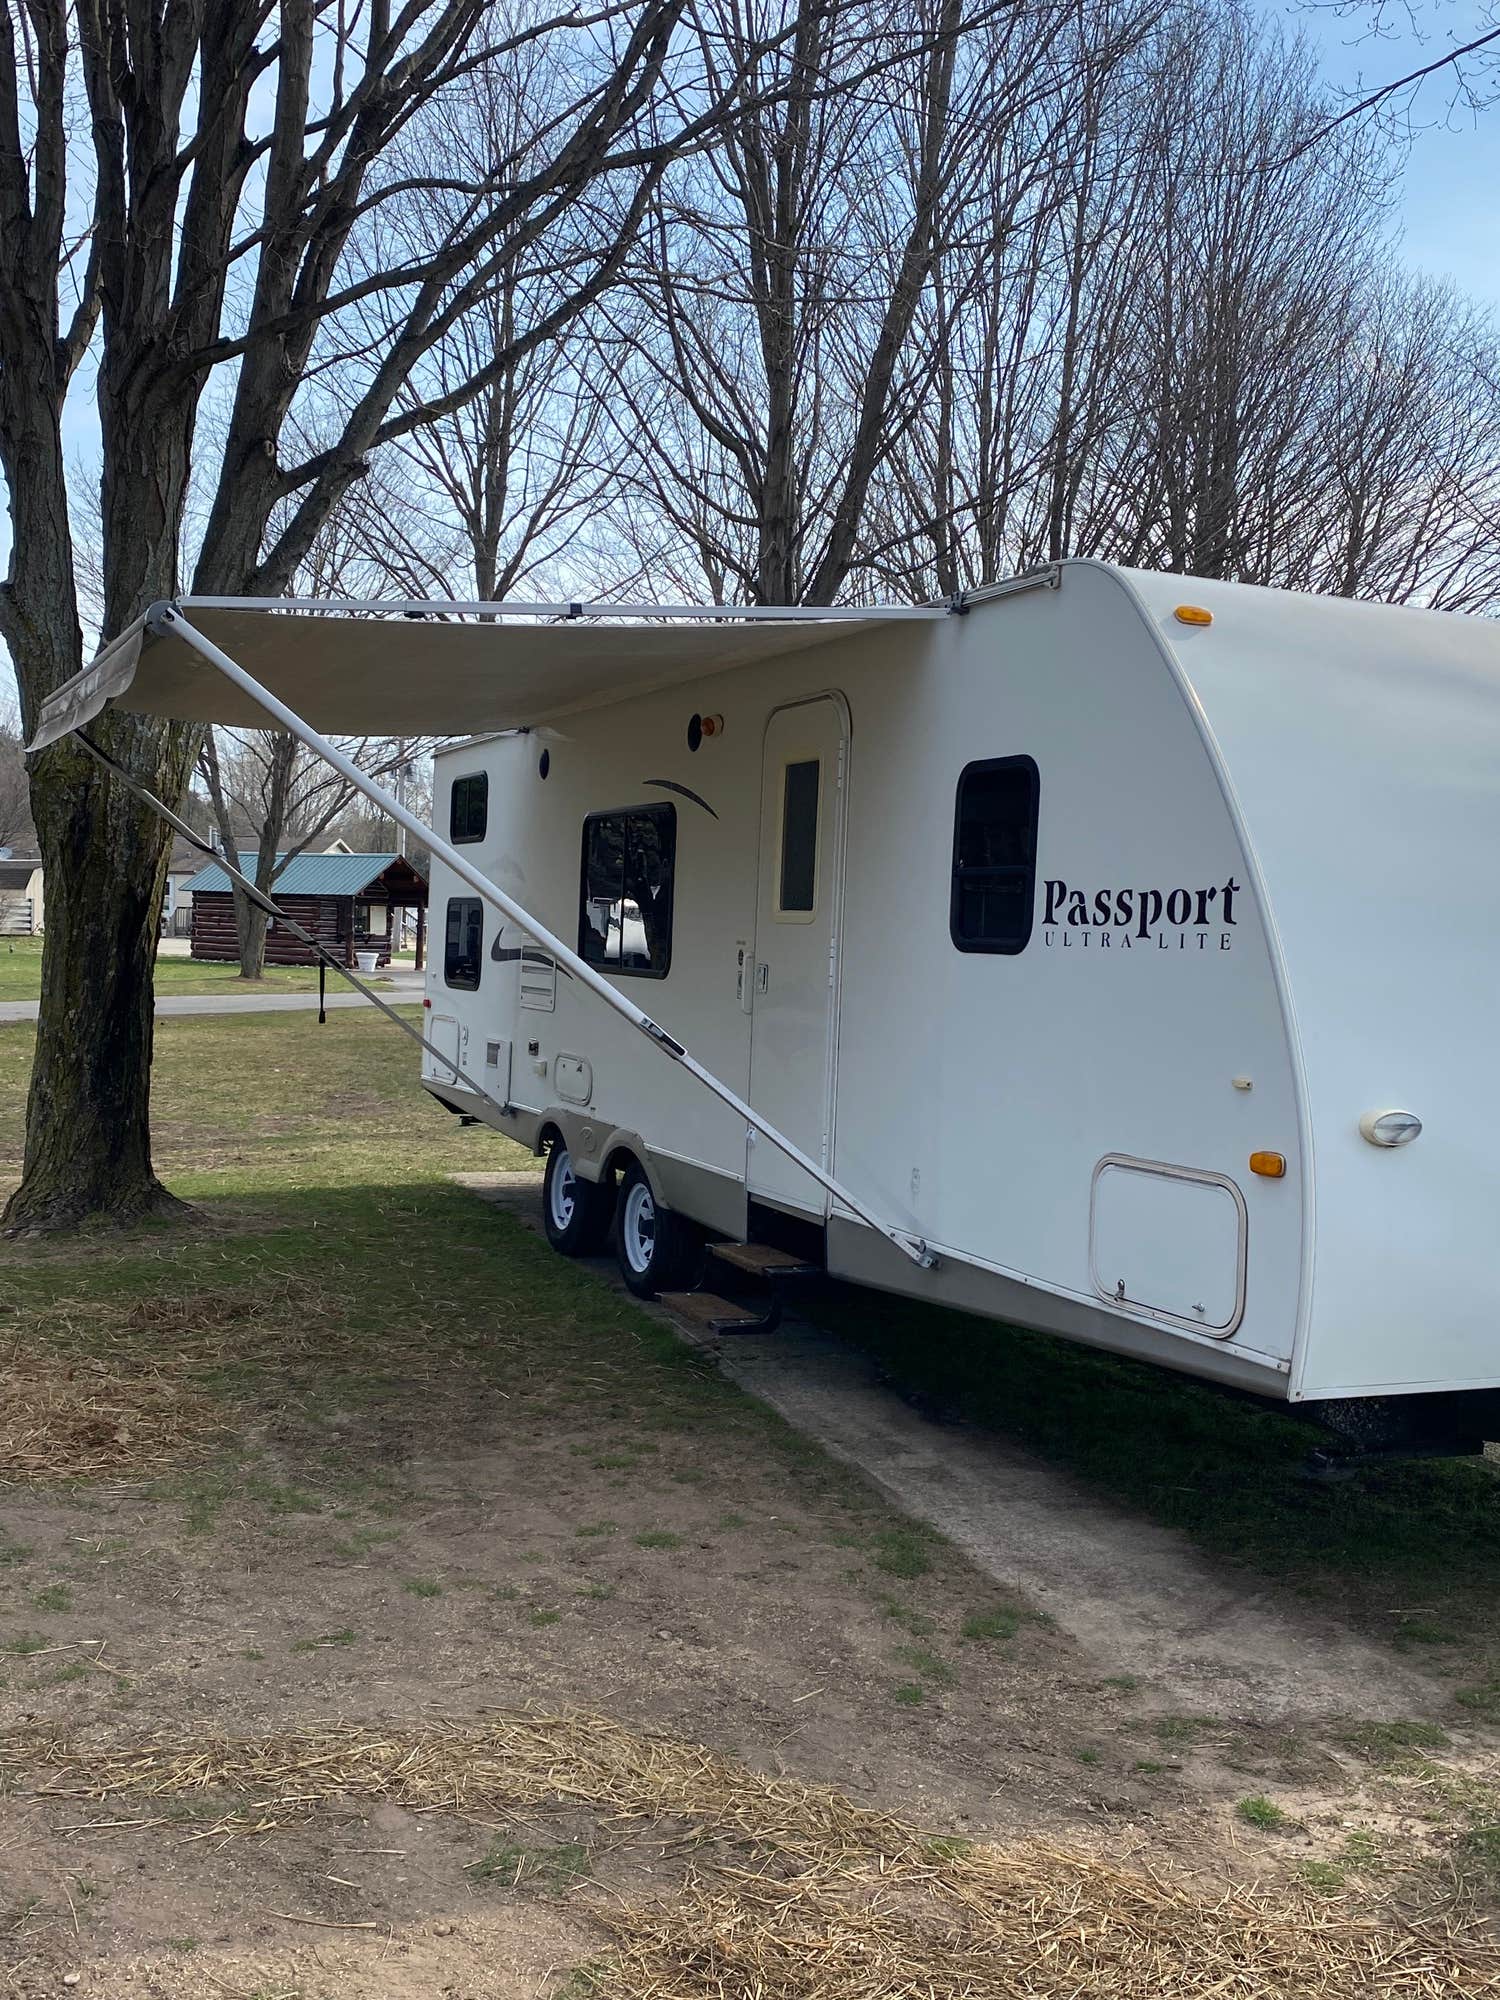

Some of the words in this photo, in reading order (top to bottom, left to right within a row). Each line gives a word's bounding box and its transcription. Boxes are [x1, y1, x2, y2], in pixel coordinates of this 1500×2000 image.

[1042, 876, 1240, 939] Passport
[1045, 931, 1132, 948] ULTRA
[1158, 932, 1232, 950] LITE
